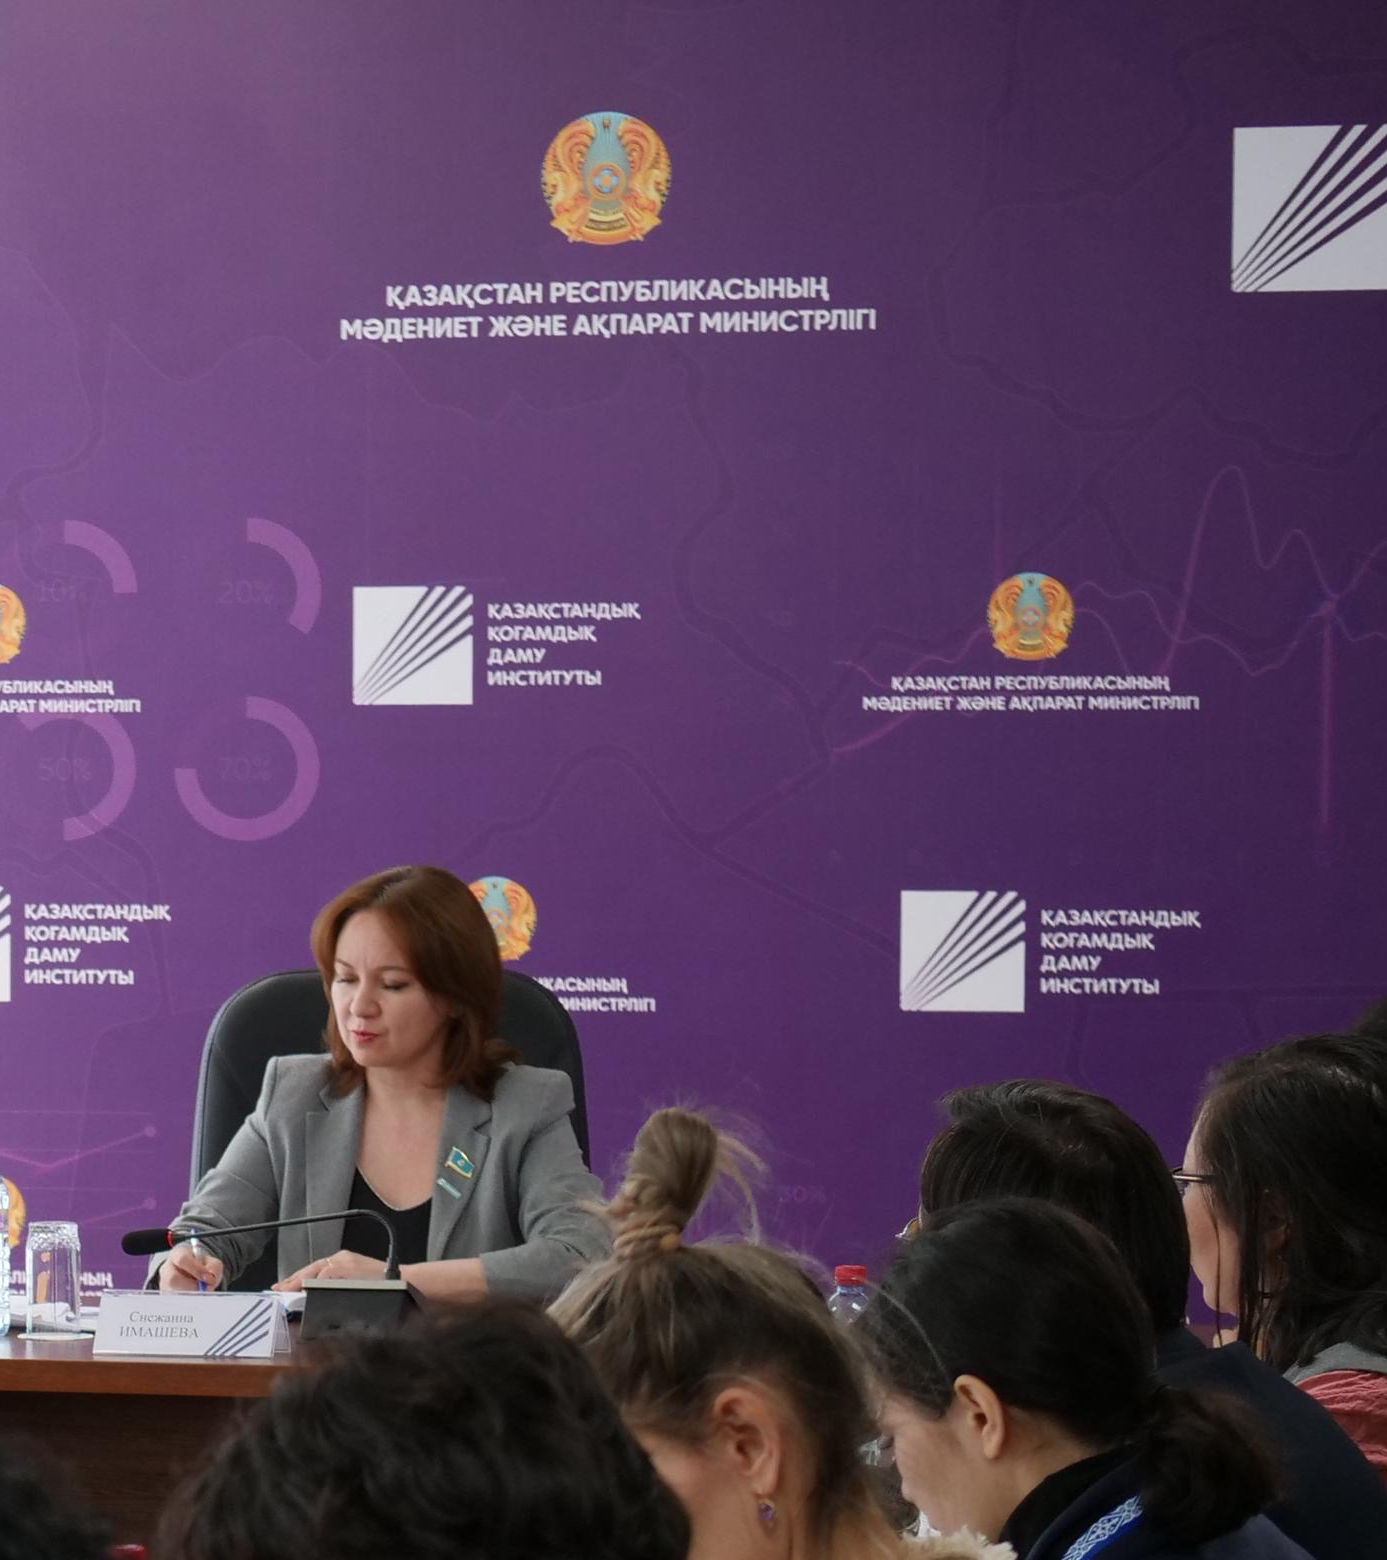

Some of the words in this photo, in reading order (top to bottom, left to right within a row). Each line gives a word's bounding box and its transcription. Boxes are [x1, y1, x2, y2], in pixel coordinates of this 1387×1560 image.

[384, 283, 544, 310] ҚАЗАҚСТАН
[548, 275, 831, 304] РЕСПУБЛИКАСЫНЫҢ
[339, 315, 483, 343] МӘДЕНИЕТ
[488, 314, 568, 337] ЖӘНЕ
[572, 312, 694, 339] АҚПАРАТ
[698, 308, 877, 334] МИНИСТРЛІГІ
[487, 602, 642, 620] ҚАЗАҚСТАНДЫҚ
[486, 647, 546, 666] ДАМУ
[486, 669, 603, 687] ИНСТИТУТЫ
[891, 675, 991, 692] ҚАЗАҚСТАН
[994, 675, 1171, 692] РЕСПУБЛИКАСЫНЫҢ
[39, 698, 141, 714] МИНИСТРЛІГІ
[862, 695, 953, 713] МӘДЕНИЕТ
[956, 695, 1006, 711] ЖӘНЕ
[1008, 695, 1085, 712] АҚПАРАТ
[1087, 695, 1200, 711] МИНИСТРЛІГІ
[24, 903, 172, 922] ҚАЗАҚСТАНДЫҚ
[1040, 909, 1201, 929] ҚАЗАҚСТАНДЫҚ
[24, 946, 81, 965] ДАМУ
[1039, 954, 1102, 974] ДАМУ
[24, 968, 134, 986] ИНСТИТУТЫ
[1039, 977, 1160, 996] ИНСТИТУТЫ
[119, 1326, 199, 1338] ИМАШЕВА
